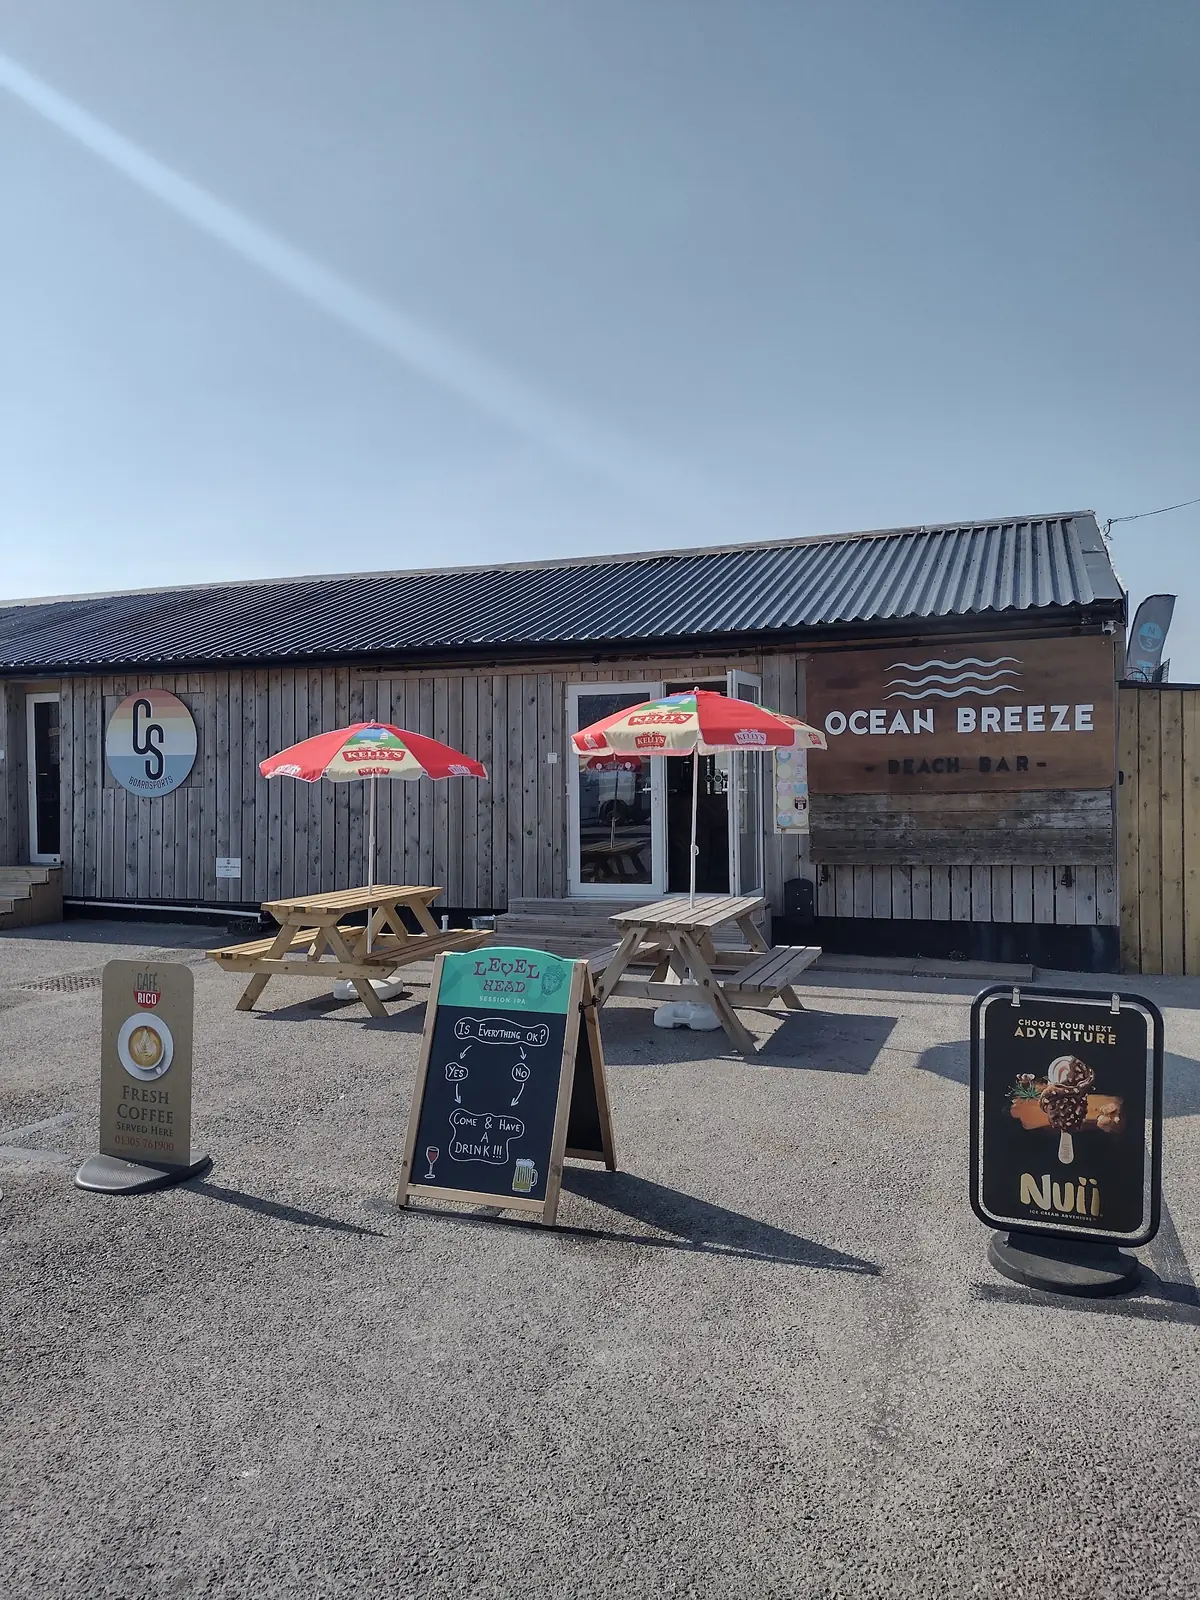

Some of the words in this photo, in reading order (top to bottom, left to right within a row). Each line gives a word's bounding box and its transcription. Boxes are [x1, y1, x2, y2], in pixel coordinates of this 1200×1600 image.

[633, 714, 689, 723] KELLY'S
[824, 709, 935, 736] OCEAN
[957, 704, 1094, 733] BREEZE
[637, 736, 665, 745] KELLY'S
[346, 751, 402, 759] KELLY'S
[128, 775, 174, 790] BOARDSPORTS
[473, 957, 540, 979] LEVEL
[483, 979, 526, 993] HEAD
[137, 992, 158, 1005] RICO
[479, 995, 511, 1004] SESSION
[458, 1022, 470, 1035] IS
[478, 1024, 521, 1041] EVERYTHING
[526, 1030, 546, 1043] OK?
[1018, 1019, 1056, 1028] CHOOSE
[1059, 1022, 1085, 1030] YOUR
[1088, 1025, 1112, 1033] NEXT
[1014, 1026, 1117, 1045] ADVENTURE
[448, 1065, 464, 1078] YES
[515, 1067, 528, 1078] NO
[122, 1085, 169, 1104] FRESH
[116, 1104, 174, 1124] COFFEE
[116, 1121, 148, 1134] SERVED
[151, 1126, 174, 1138] HERE
[453, 1112, 478, 1127] COME
[484, 1117, 493, 1129] &
[499, 1119, 521, 1133] HAVE
[115, 1135, 140, 1147] 01305
[480, 1132, 489, 1143] A
[455, 1143, 490, 1157] DRINK
